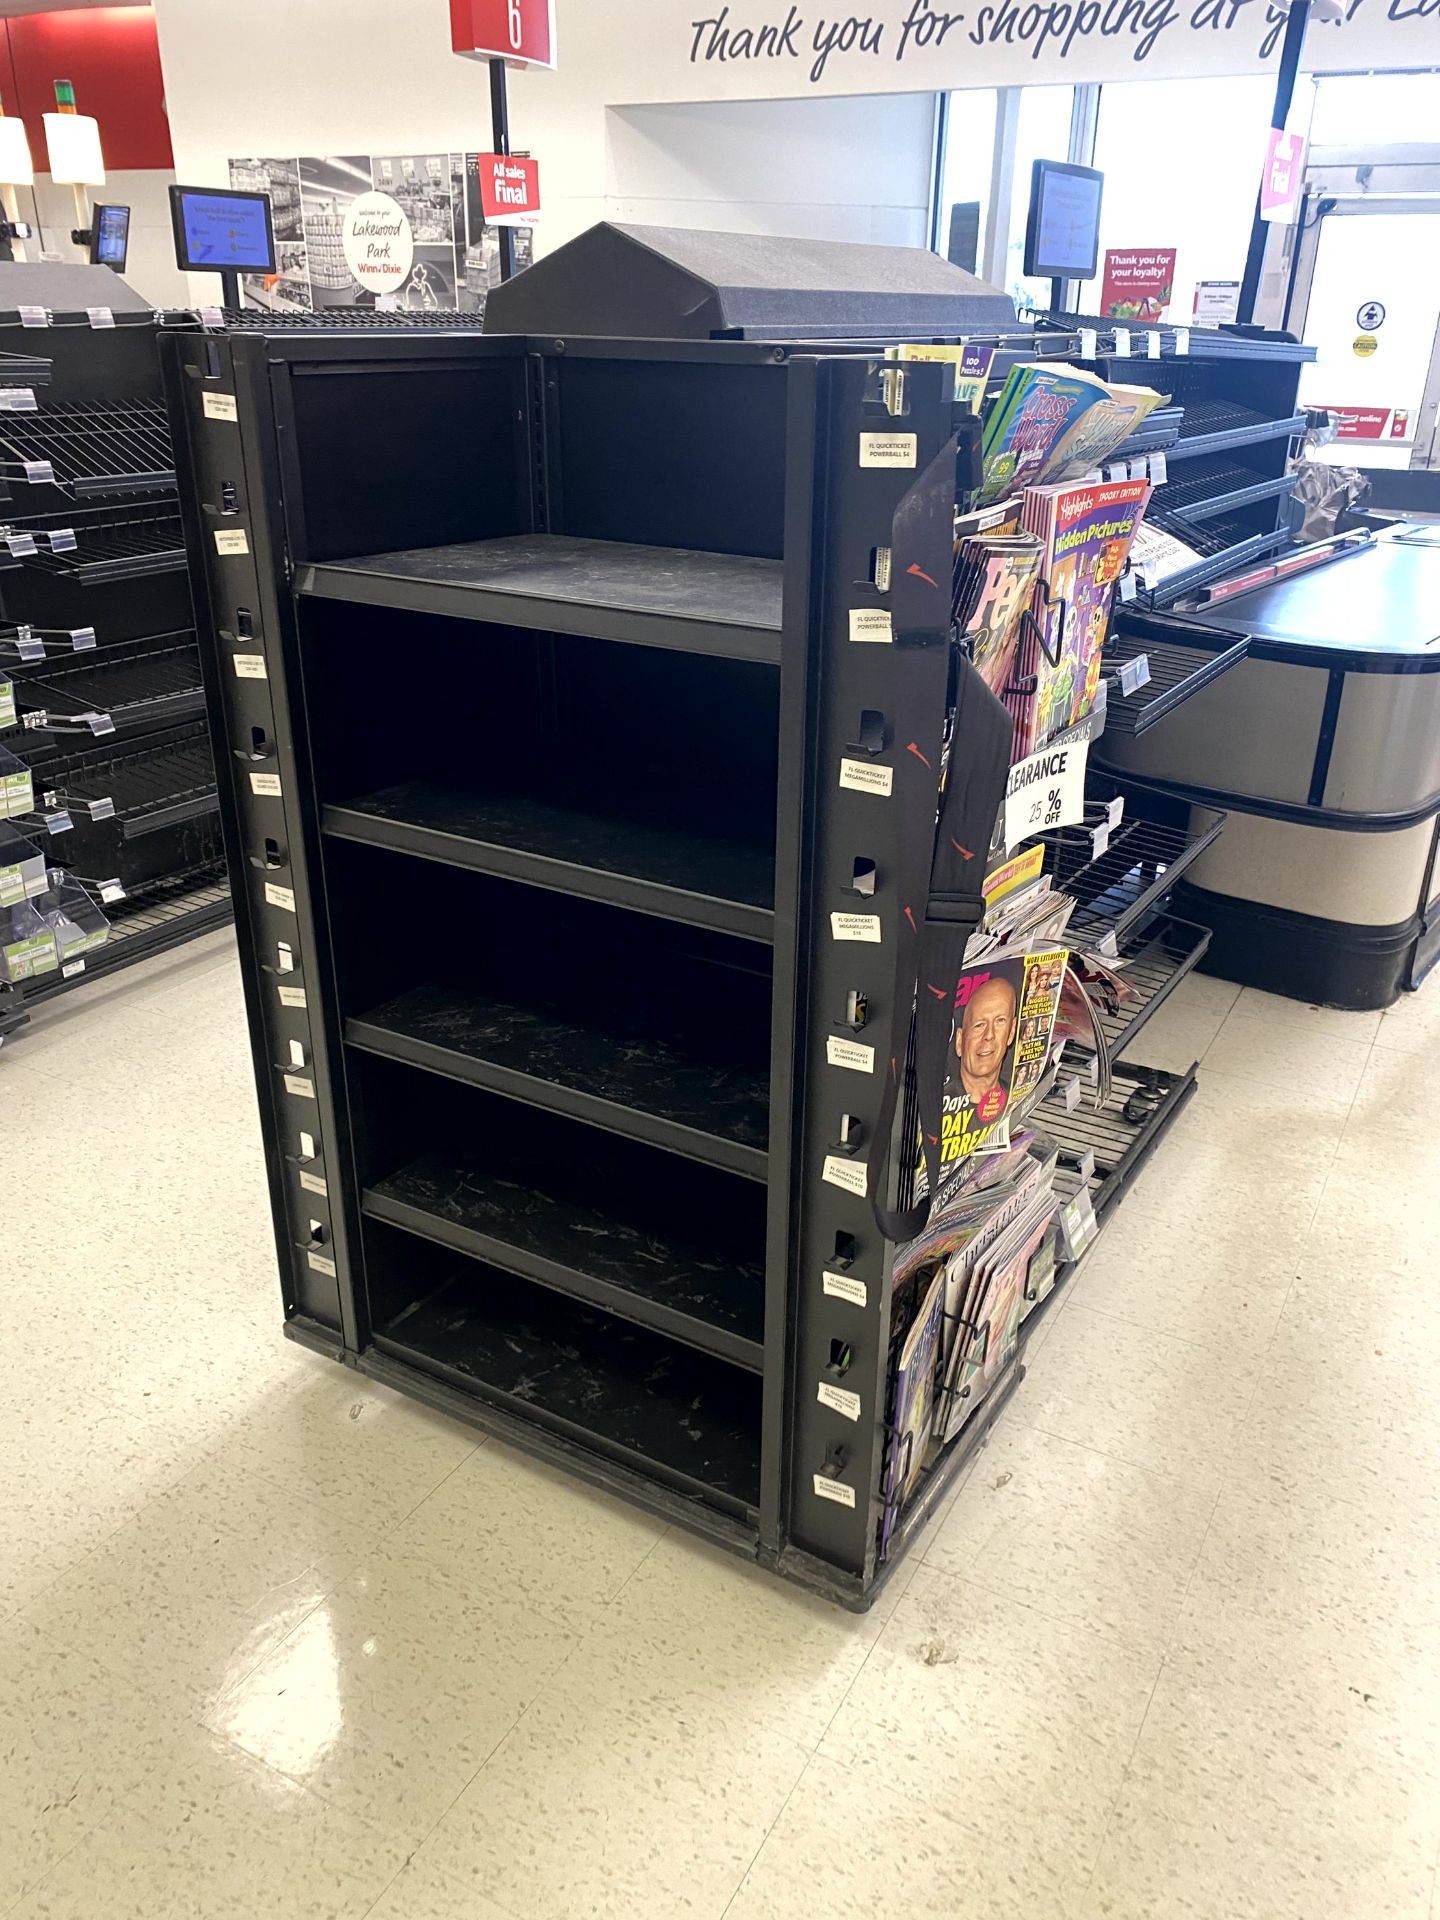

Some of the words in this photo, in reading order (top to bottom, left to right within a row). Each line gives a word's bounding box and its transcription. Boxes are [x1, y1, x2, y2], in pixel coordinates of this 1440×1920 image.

[506, 0, 522, 49] 6
[690, 6, 803, 62] Thank
[811, 17, 884, 82] you
[895, 0, 964, 60] for
[968, 0, 1180, 61] shopping
[493, 162, 504, 177] All
[505, 165, 526, 179] sales
[494, 179, 528, 205] Final
[352, 218, 403, 237] Lakewood
[366, 241, 391, 259] Park
[1109, 255, 1137, 265] Thank
[1138, 256, 1156, 267] you
[1156, 254, 1171, 265] for
[1111, 268, 1132, 279] your
[1132, 267, 1166, 279] loyalty!
[966, 357, 980, 366] 100
[961, 366, 985, 376] Puzzles!
[1021, 385, 1078, 421] Cross
[1359, 415, 1382, 423] online
[999, 461, 1010, 474] 99
[1060, 492, 1095, 521] Highlights
[1098, 489, 1120, 502] SPOOKY
[1120, 486, 1142, 497] EDITION
[1055, 528, 1087, 557] Hidden
[1087, 519, 1134, 543] Pictures
[844, 772, 882, 786] MEGAMILLIONS
[854, 768, 886, 780] QUICKTICKET
[1006, 751, 1069, 799] LEARANCE
[1029, 801, 1043, 823] 25
[1048, 788, 1062, 812] %
[1044, 811, 1062, 825] OFF
[834, 1054, 861, 1064] POWERBALL
[942, 1093, 971, 1114] Days
[941, 1108, 975, 1139] DAY
